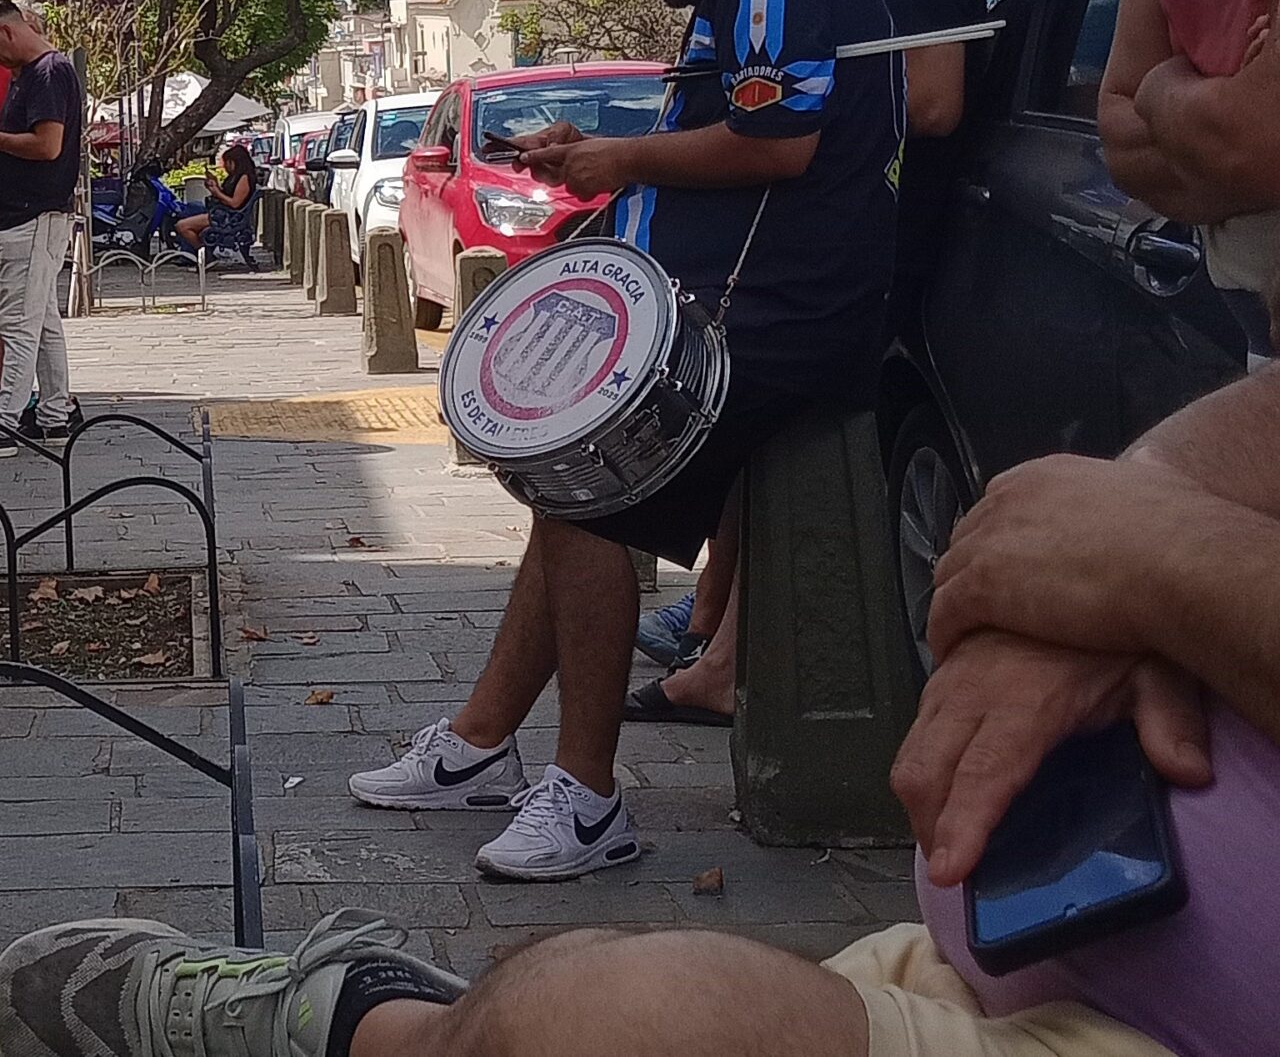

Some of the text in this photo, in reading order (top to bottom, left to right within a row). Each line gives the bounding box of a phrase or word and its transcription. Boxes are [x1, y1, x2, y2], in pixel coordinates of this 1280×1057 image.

[559, 259, 645, 306] ALTA GRACIA
[461, 389, 476, 409] ES
[467, 405, 486, 426] DE
